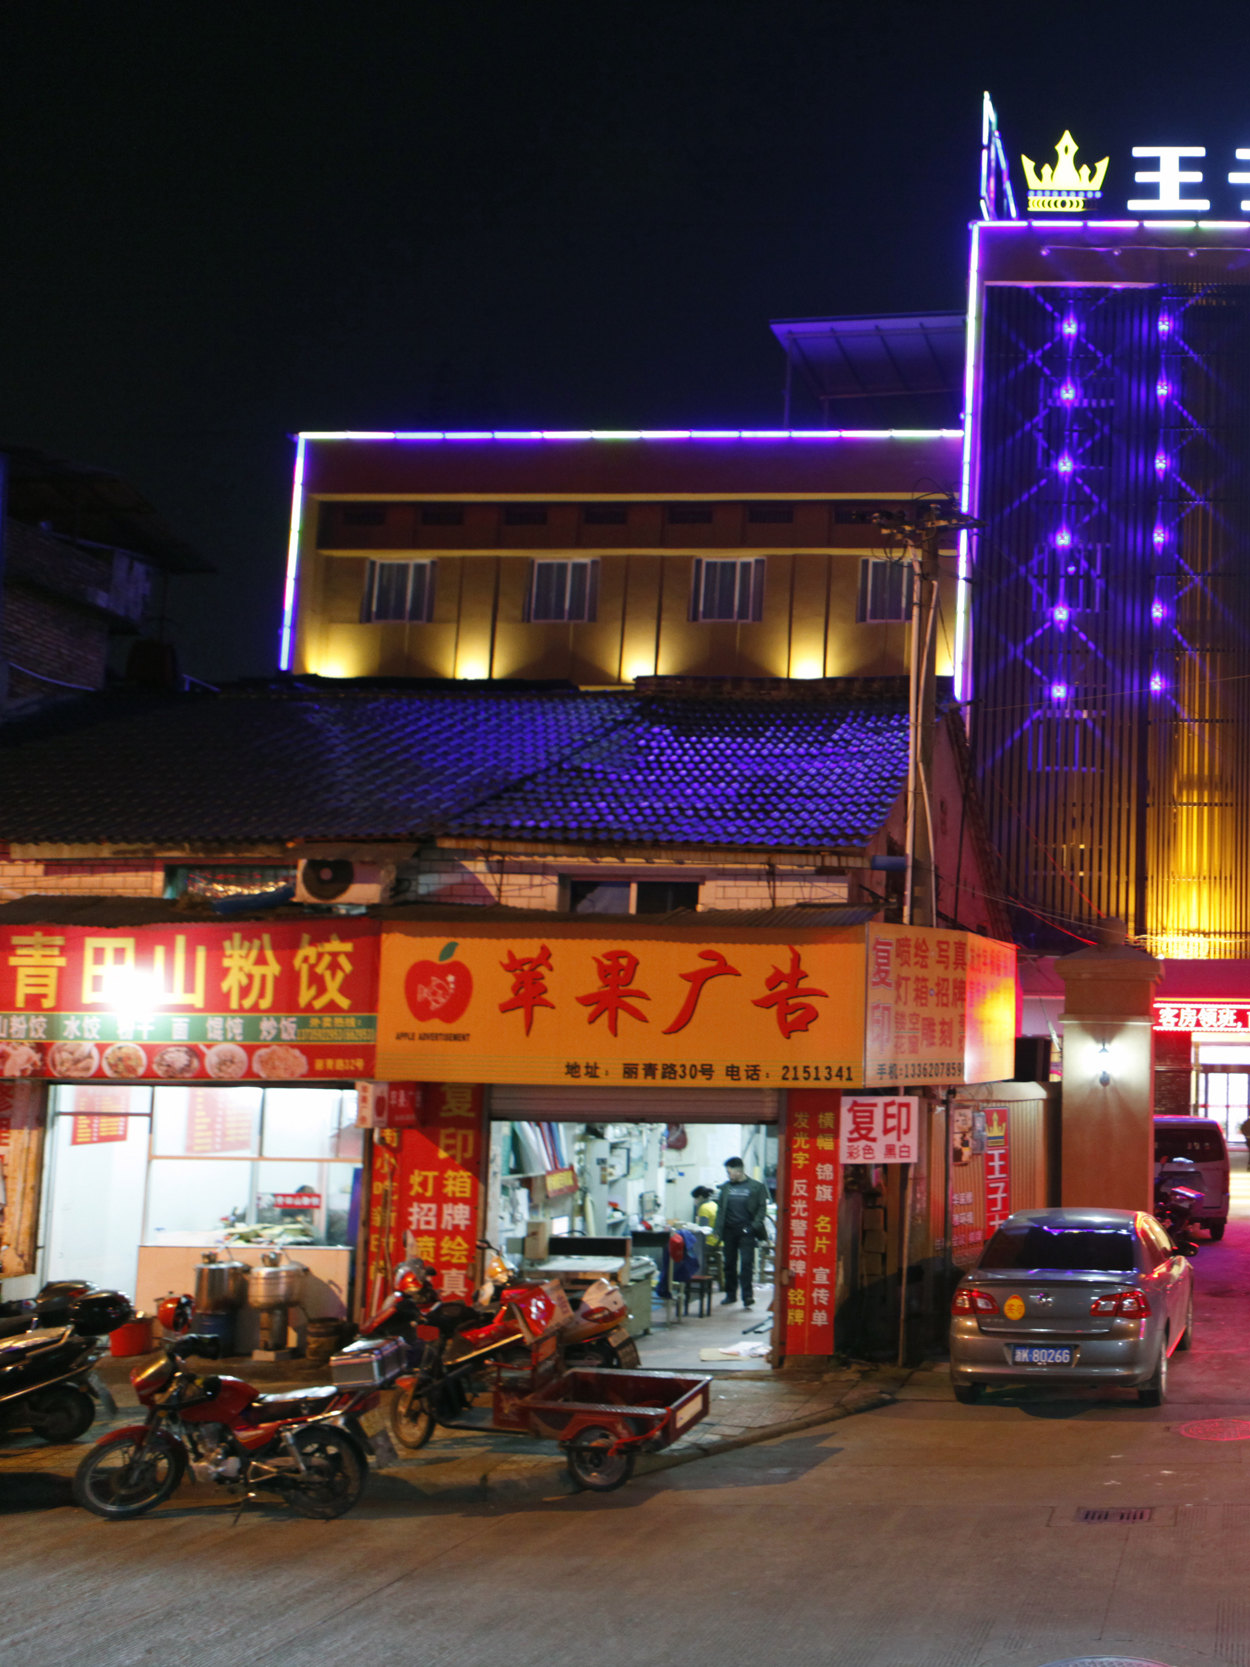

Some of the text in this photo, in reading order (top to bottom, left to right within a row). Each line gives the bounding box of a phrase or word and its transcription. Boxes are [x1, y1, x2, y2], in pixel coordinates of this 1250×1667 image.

[8, 931, 354, 1011] 青田山粉饺
[498, 943, 829, 1039] 苹果广告
[871, 936, 894, 1054] 复印
[63, 1015, 101, 1039] 水饺
[206, 1016, 244, 1041] 馄饨
[259, 1016, 297, 1041] 炒饭
[438, 1083, 476, 1166] 复印
[791, 1112, 811, 1169] 发光字
[846, 1100, 912, 1143] 复印
[846, 1143, 911, 1160] 彩色 黑白
[407, 1201, 471, 1231] 招牌
[409, 1168, 473, 1199] 灯箱
[788, 1179, 809, 1278] 反光警示牌
[810, 1112, 835, 1328] 横幅 锦旗 名片 宣传单
